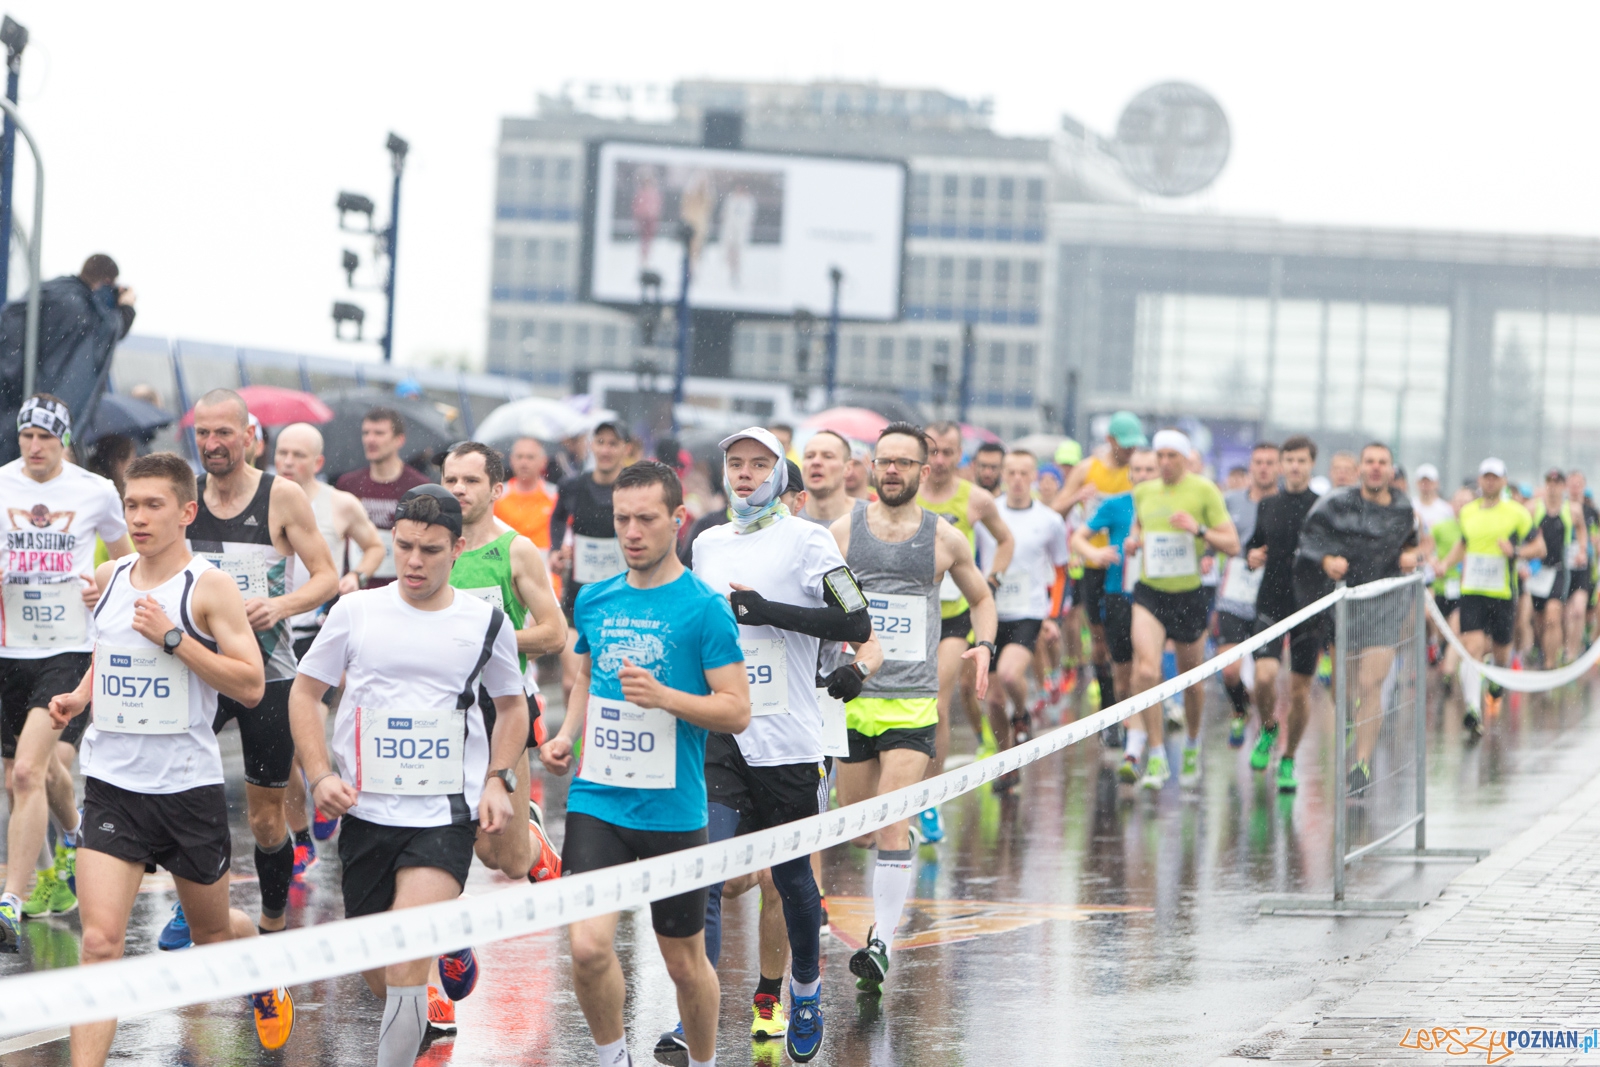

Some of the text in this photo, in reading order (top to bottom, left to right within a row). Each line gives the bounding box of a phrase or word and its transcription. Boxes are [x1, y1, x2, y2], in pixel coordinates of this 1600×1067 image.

[7, 533, 76, 550] SMASHING
[8, 551, 74, 573] PAPKINS
[236, 574, 250, 591] 3
[22, 605, 66, 622] 8132
[869, 614, 912, 634] 323
[746, 664, 773, 685] 59
[101, 674, 170, 699] 10576
[121, 700, 144, 708] Hubert
[374, 737, 450, 759] 13026
[594, 726, 655, 753] 6930
[609, 753, 632, 761] Marcin
